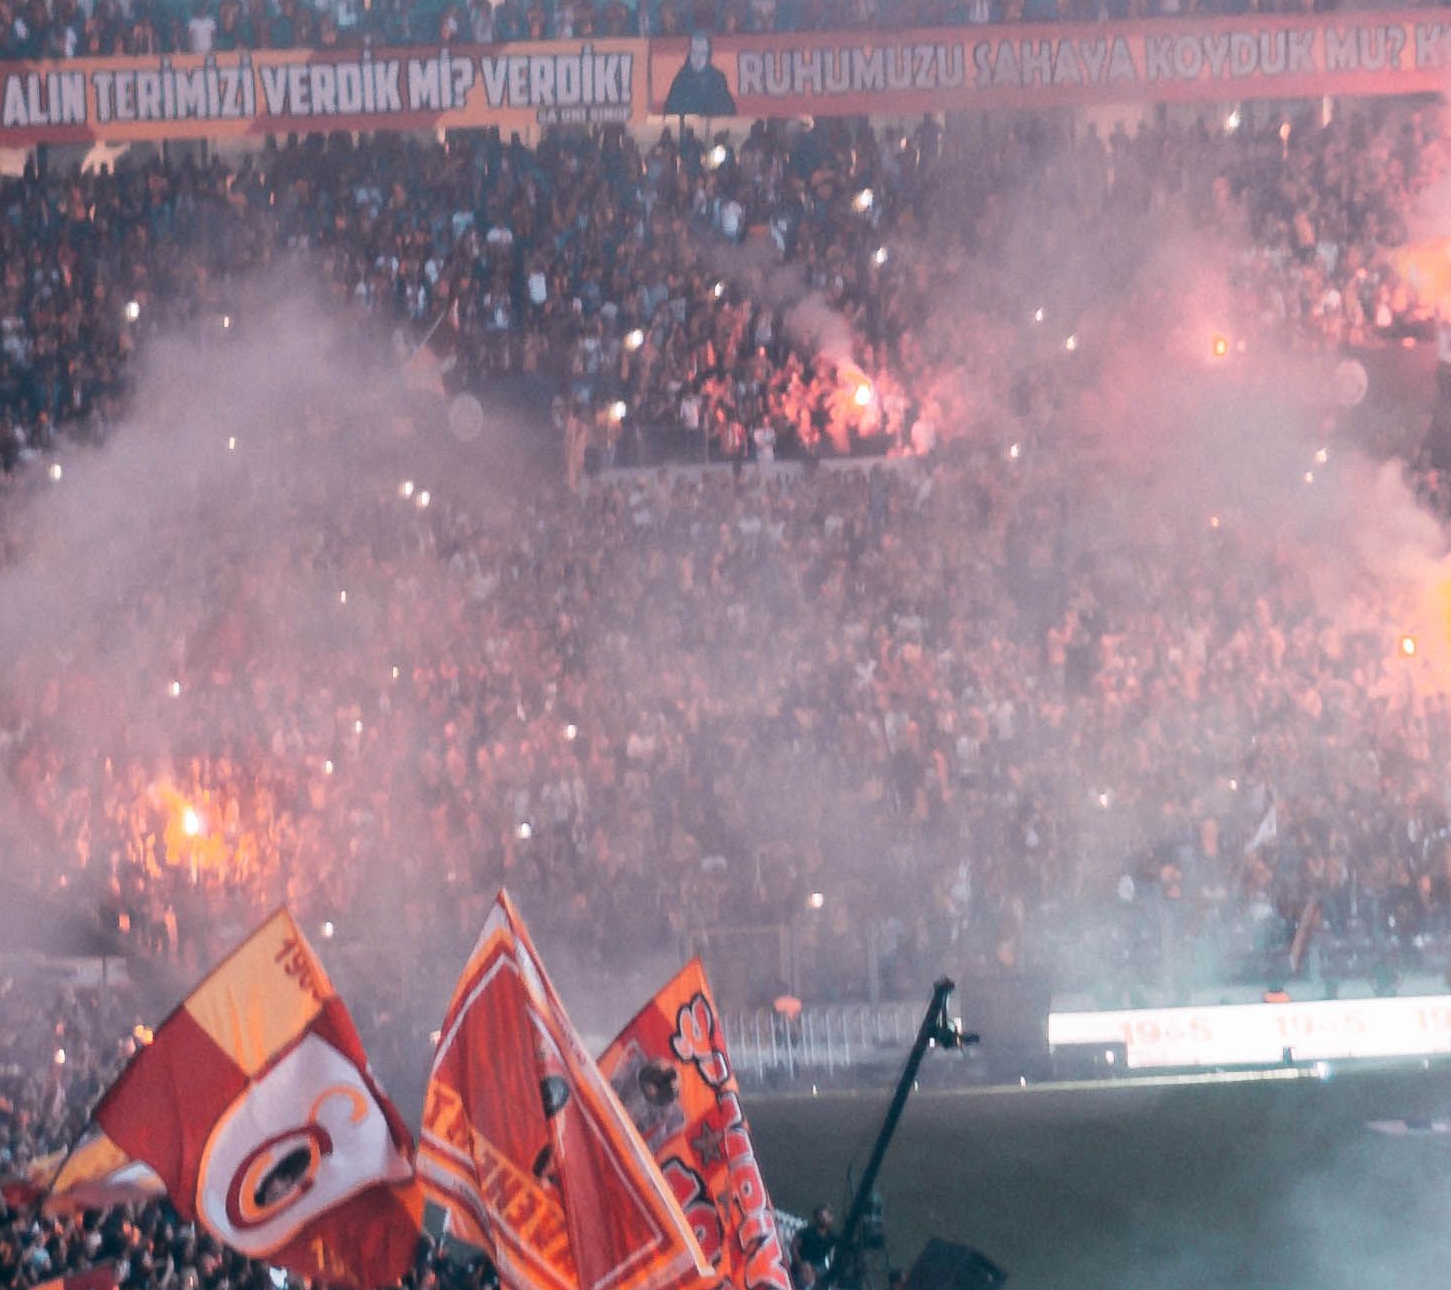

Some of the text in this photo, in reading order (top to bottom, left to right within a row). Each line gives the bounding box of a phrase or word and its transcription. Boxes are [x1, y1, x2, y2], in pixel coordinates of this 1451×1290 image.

[2, 71, 87, 126] ALIN
[93, 53, 256, 122] TERİMİZİ
[259, 47, 401, 114] VERDİK
[481, 42, 633, 107] VERDİK!
[736, 43, 966, 96] RUHUMUZU
[973, 34, 1138, 89] SAHAYA
[1144, 28, 1316, 82] KOYDUK
[1324, 23, 1407, 73] MU?
